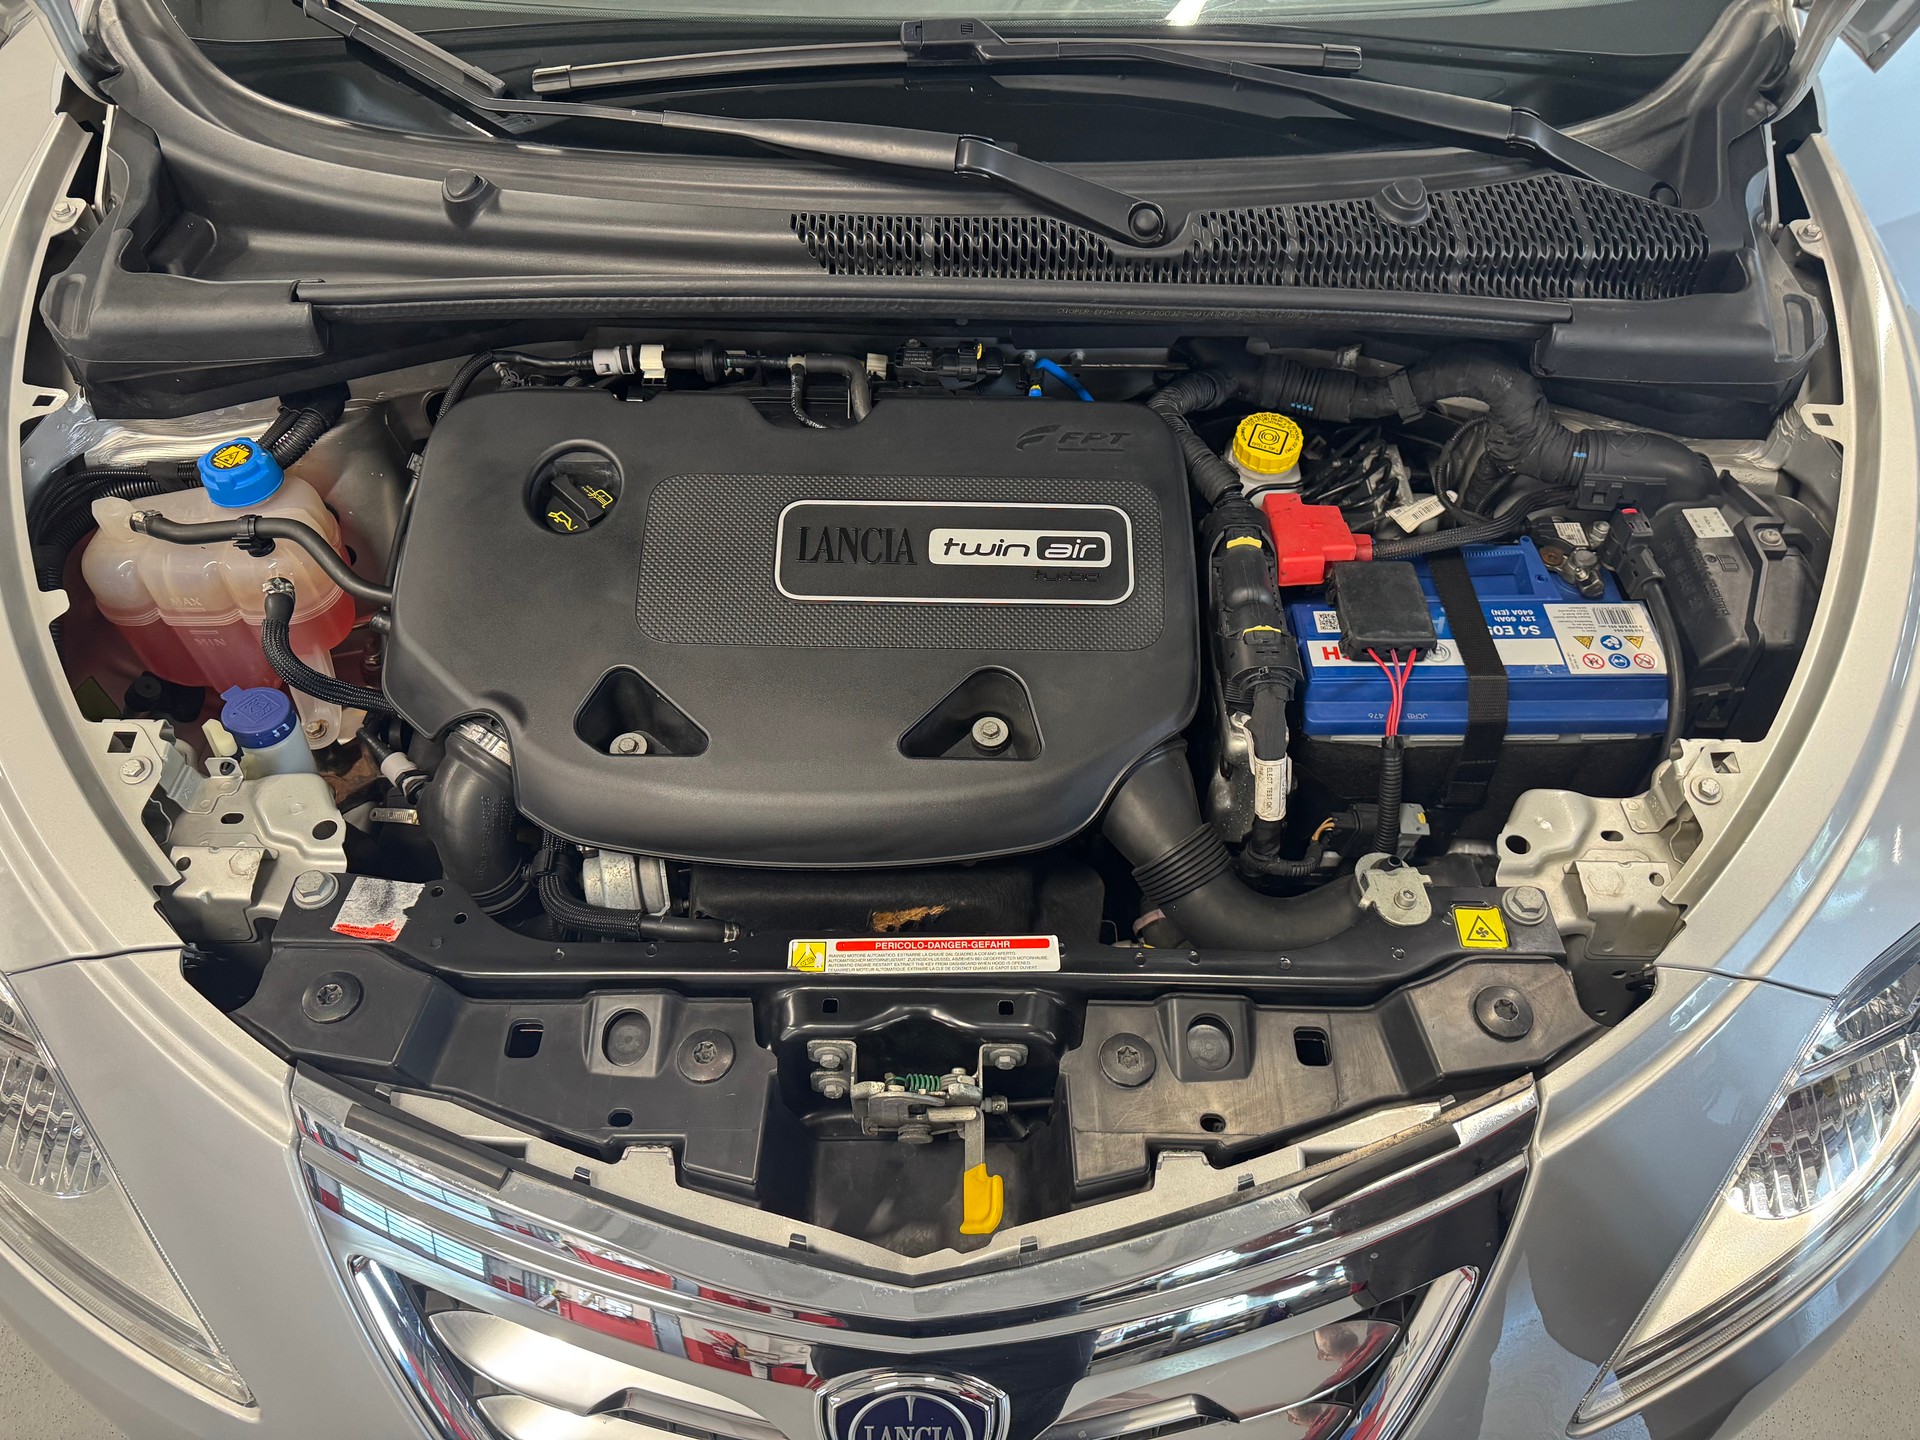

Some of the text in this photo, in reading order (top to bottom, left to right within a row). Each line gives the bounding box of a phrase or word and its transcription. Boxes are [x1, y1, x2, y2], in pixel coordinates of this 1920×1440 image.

[1058, 432, 1131, 444] FPT
[796, 526, 1098, 565] LANCIA twin air
[1034, 569, 1101, 582] turbo
[170, 597, 203, 607] MAX
[1518, 625, 1541, 635] S4
[195, 638, 225, 647] MIN
[875, 940, 1011, 950] PERICOLO-DANGER-GEFAHR
[863, 1425, 955, 1440] LANCIA
